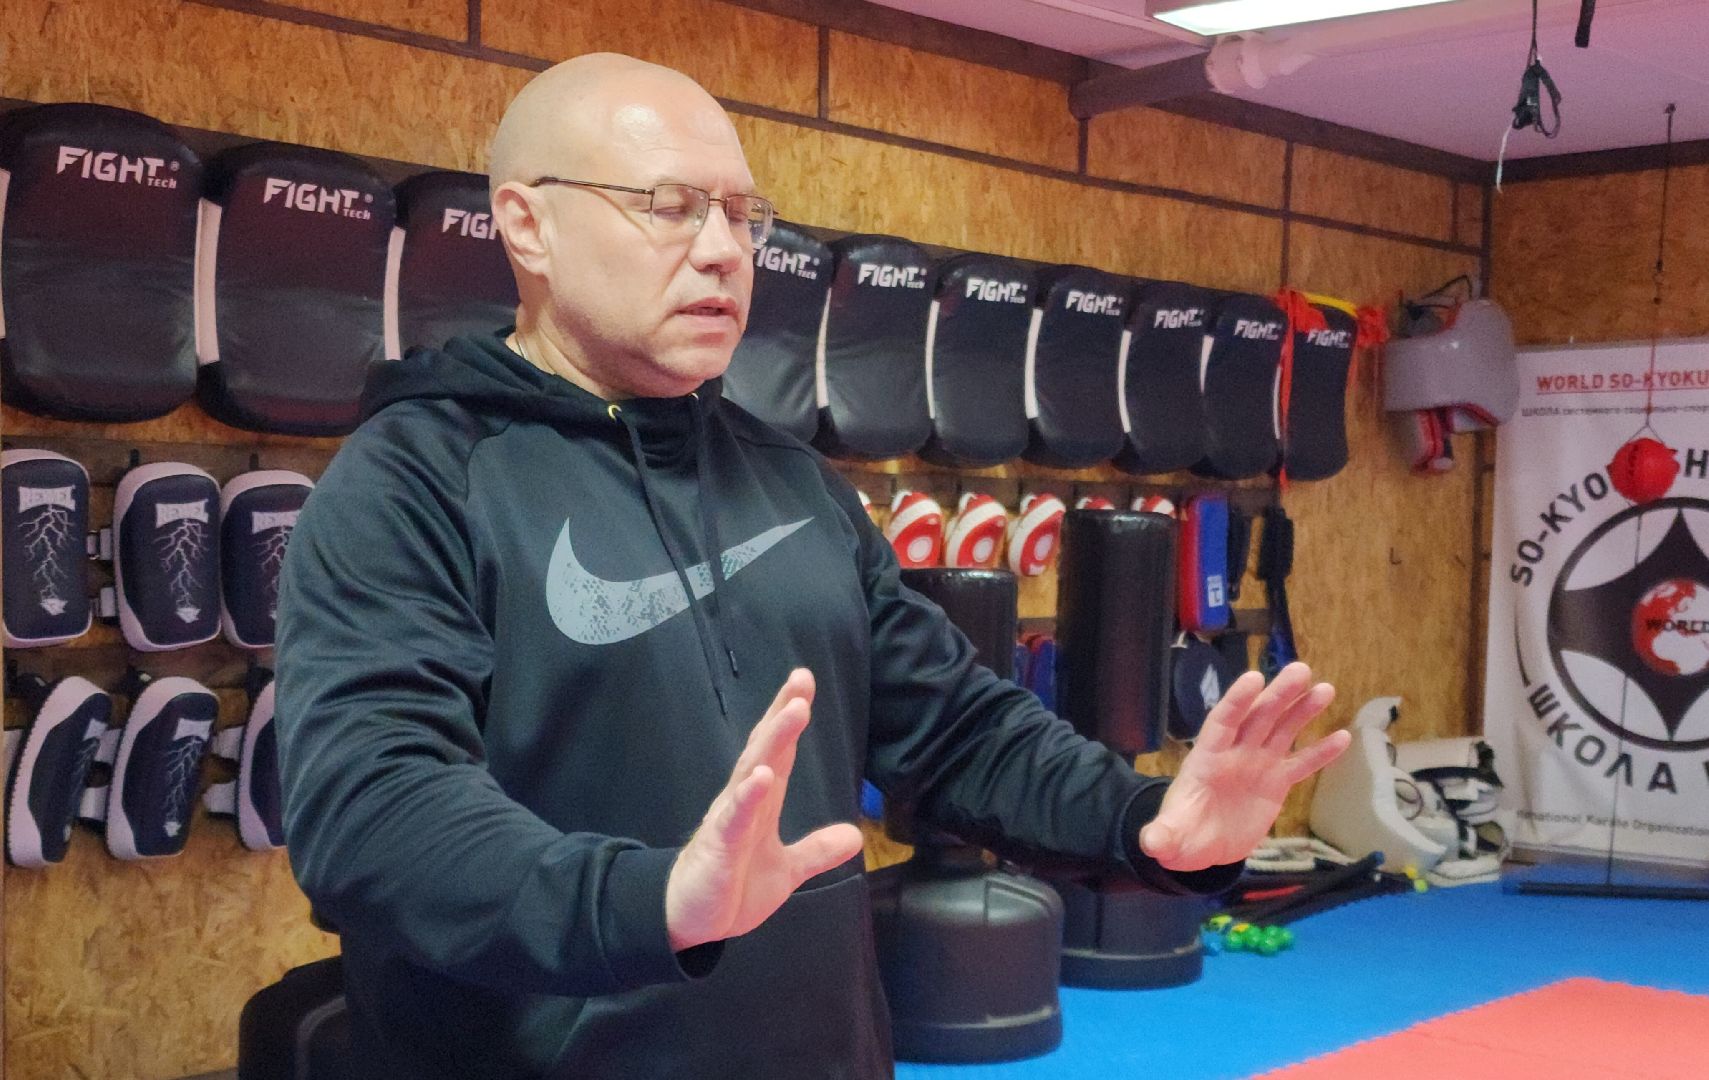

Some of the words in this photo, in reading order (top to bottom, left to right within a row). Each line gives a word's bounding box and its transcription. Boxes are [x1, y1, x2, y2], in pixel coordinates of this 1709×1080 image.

[56, 145, 165, 184] FIGHT
[147, 177, 177, 189] TECH
[263, 177, 360, 214] FIGHT
[752, 243, 811, 274] IGHT
[858, 263, 920, 288] FIGHT
[965, 278, 1021, 302] FIGHT
[1065, 290, 1118, 314] FIGHT
[1153, 309, 1199, 329] FIGHT
[1234, 319, 1278, 340] FIGHT
[1307, 328, 1348, 347] FIGHT
[1537, 373, 1604, 391] WORLD
[1528, 684, 1677, 794] ШКОЛА
